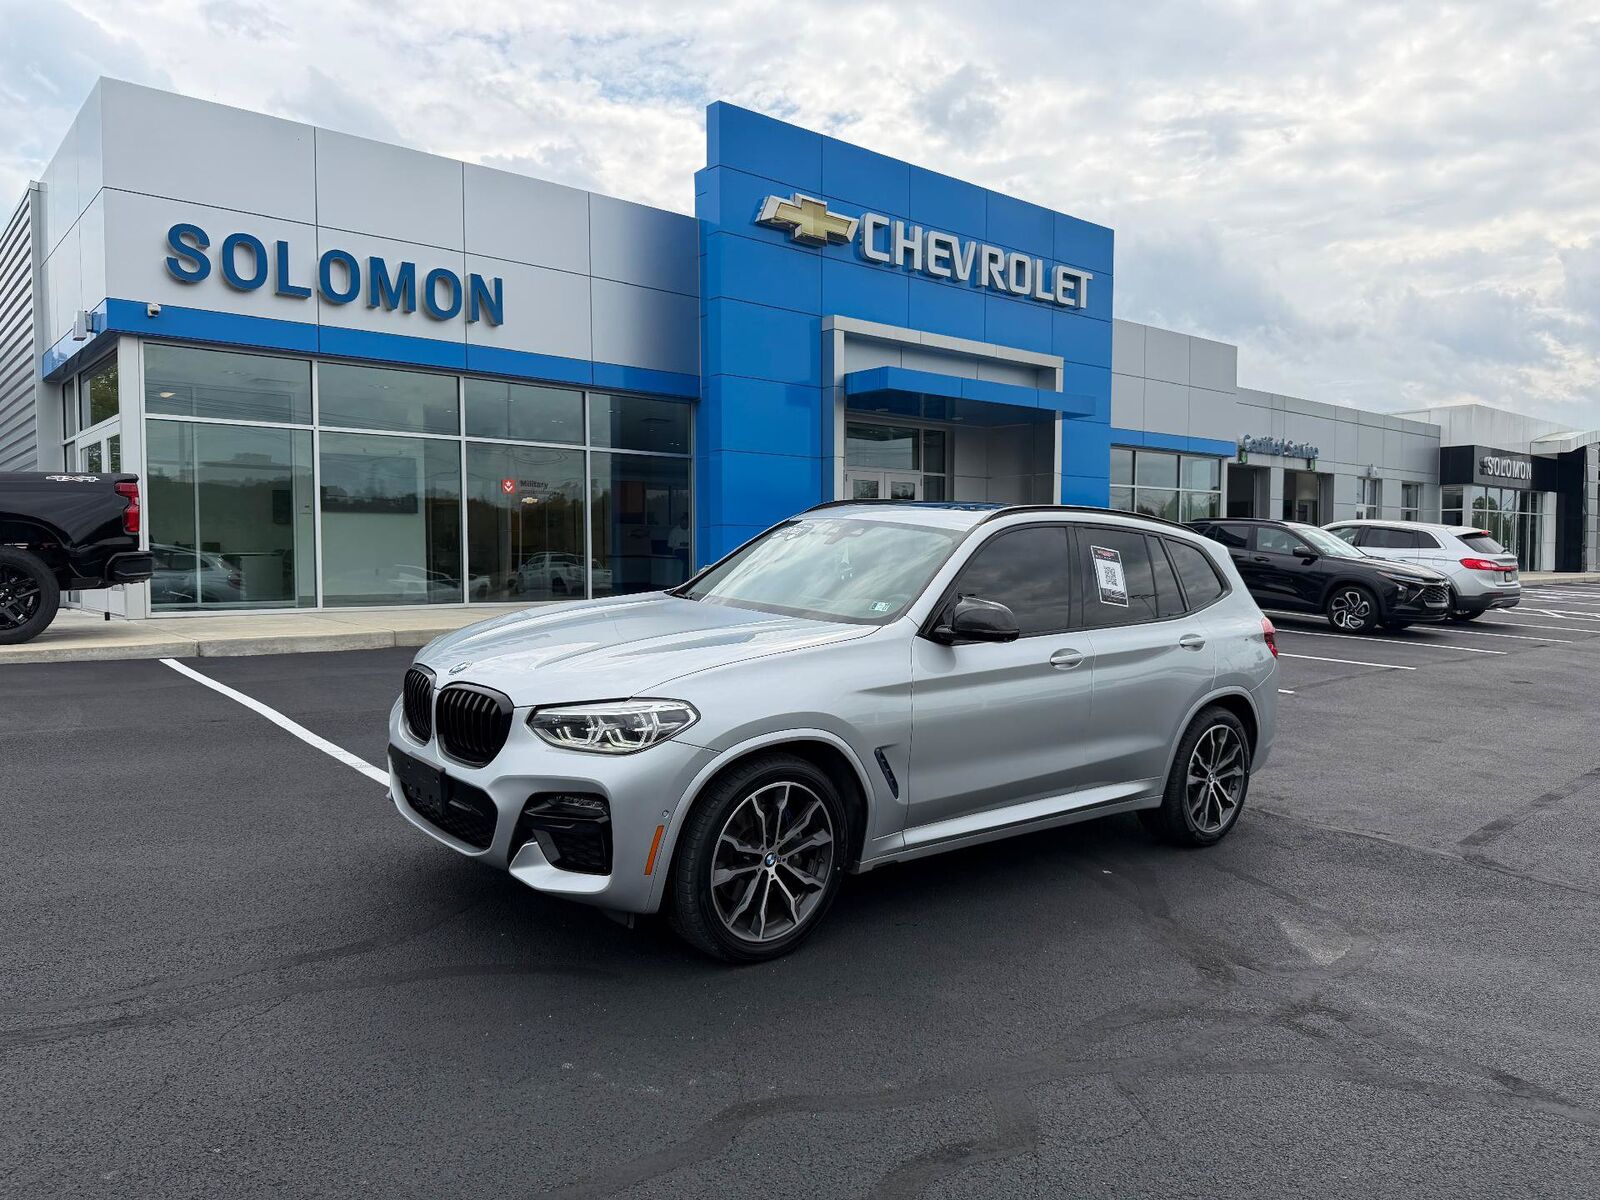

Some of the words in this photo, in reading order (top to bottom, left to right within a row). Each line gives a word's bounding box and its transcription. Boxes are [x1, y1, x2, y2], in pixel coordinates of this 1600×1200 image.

[166, 223, 504, 326] SOLOMON
[860, 212, 1094, 309] CHEVROLET
[520, 479, 549, 489] Military
[1485, 456, 1532, 479] SOLOMON
